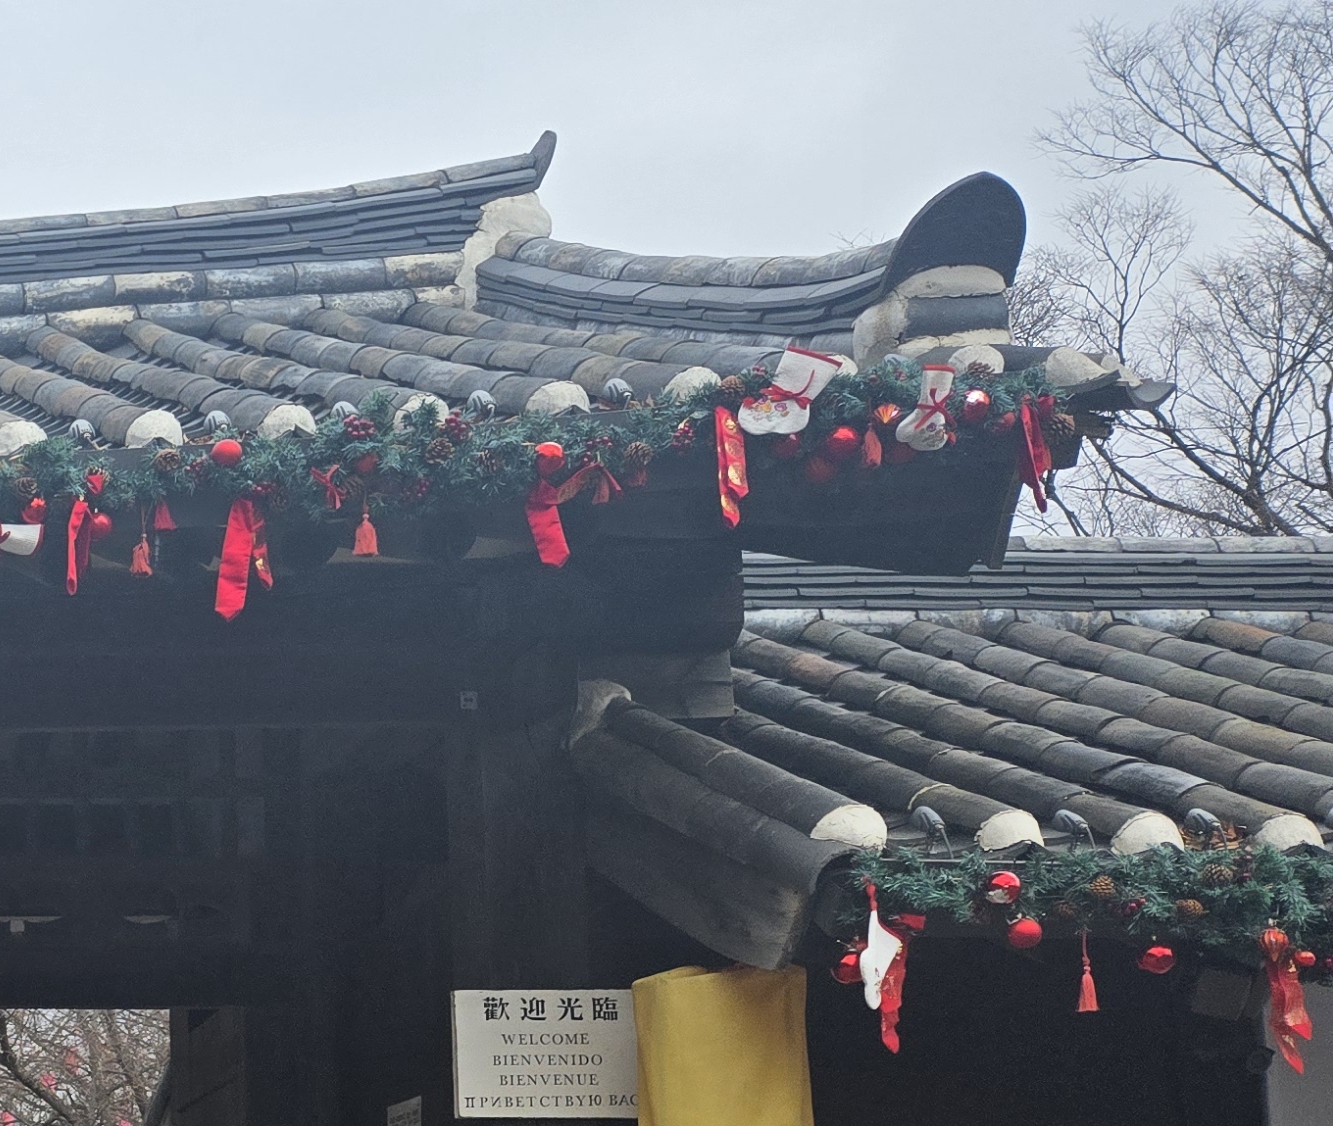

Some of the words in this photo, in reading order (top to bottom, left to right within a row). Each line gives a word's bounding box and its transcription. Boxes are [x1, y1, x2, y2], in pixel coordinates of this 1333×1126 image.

[483, 996, 619, 1021] 歡迎光臨
[501, 1032, 590, 1045] WELCOME
[492, 1054, 604, 1066] BIENVENIDO
[499, 1073, 600, 1086] BIENVENUE
